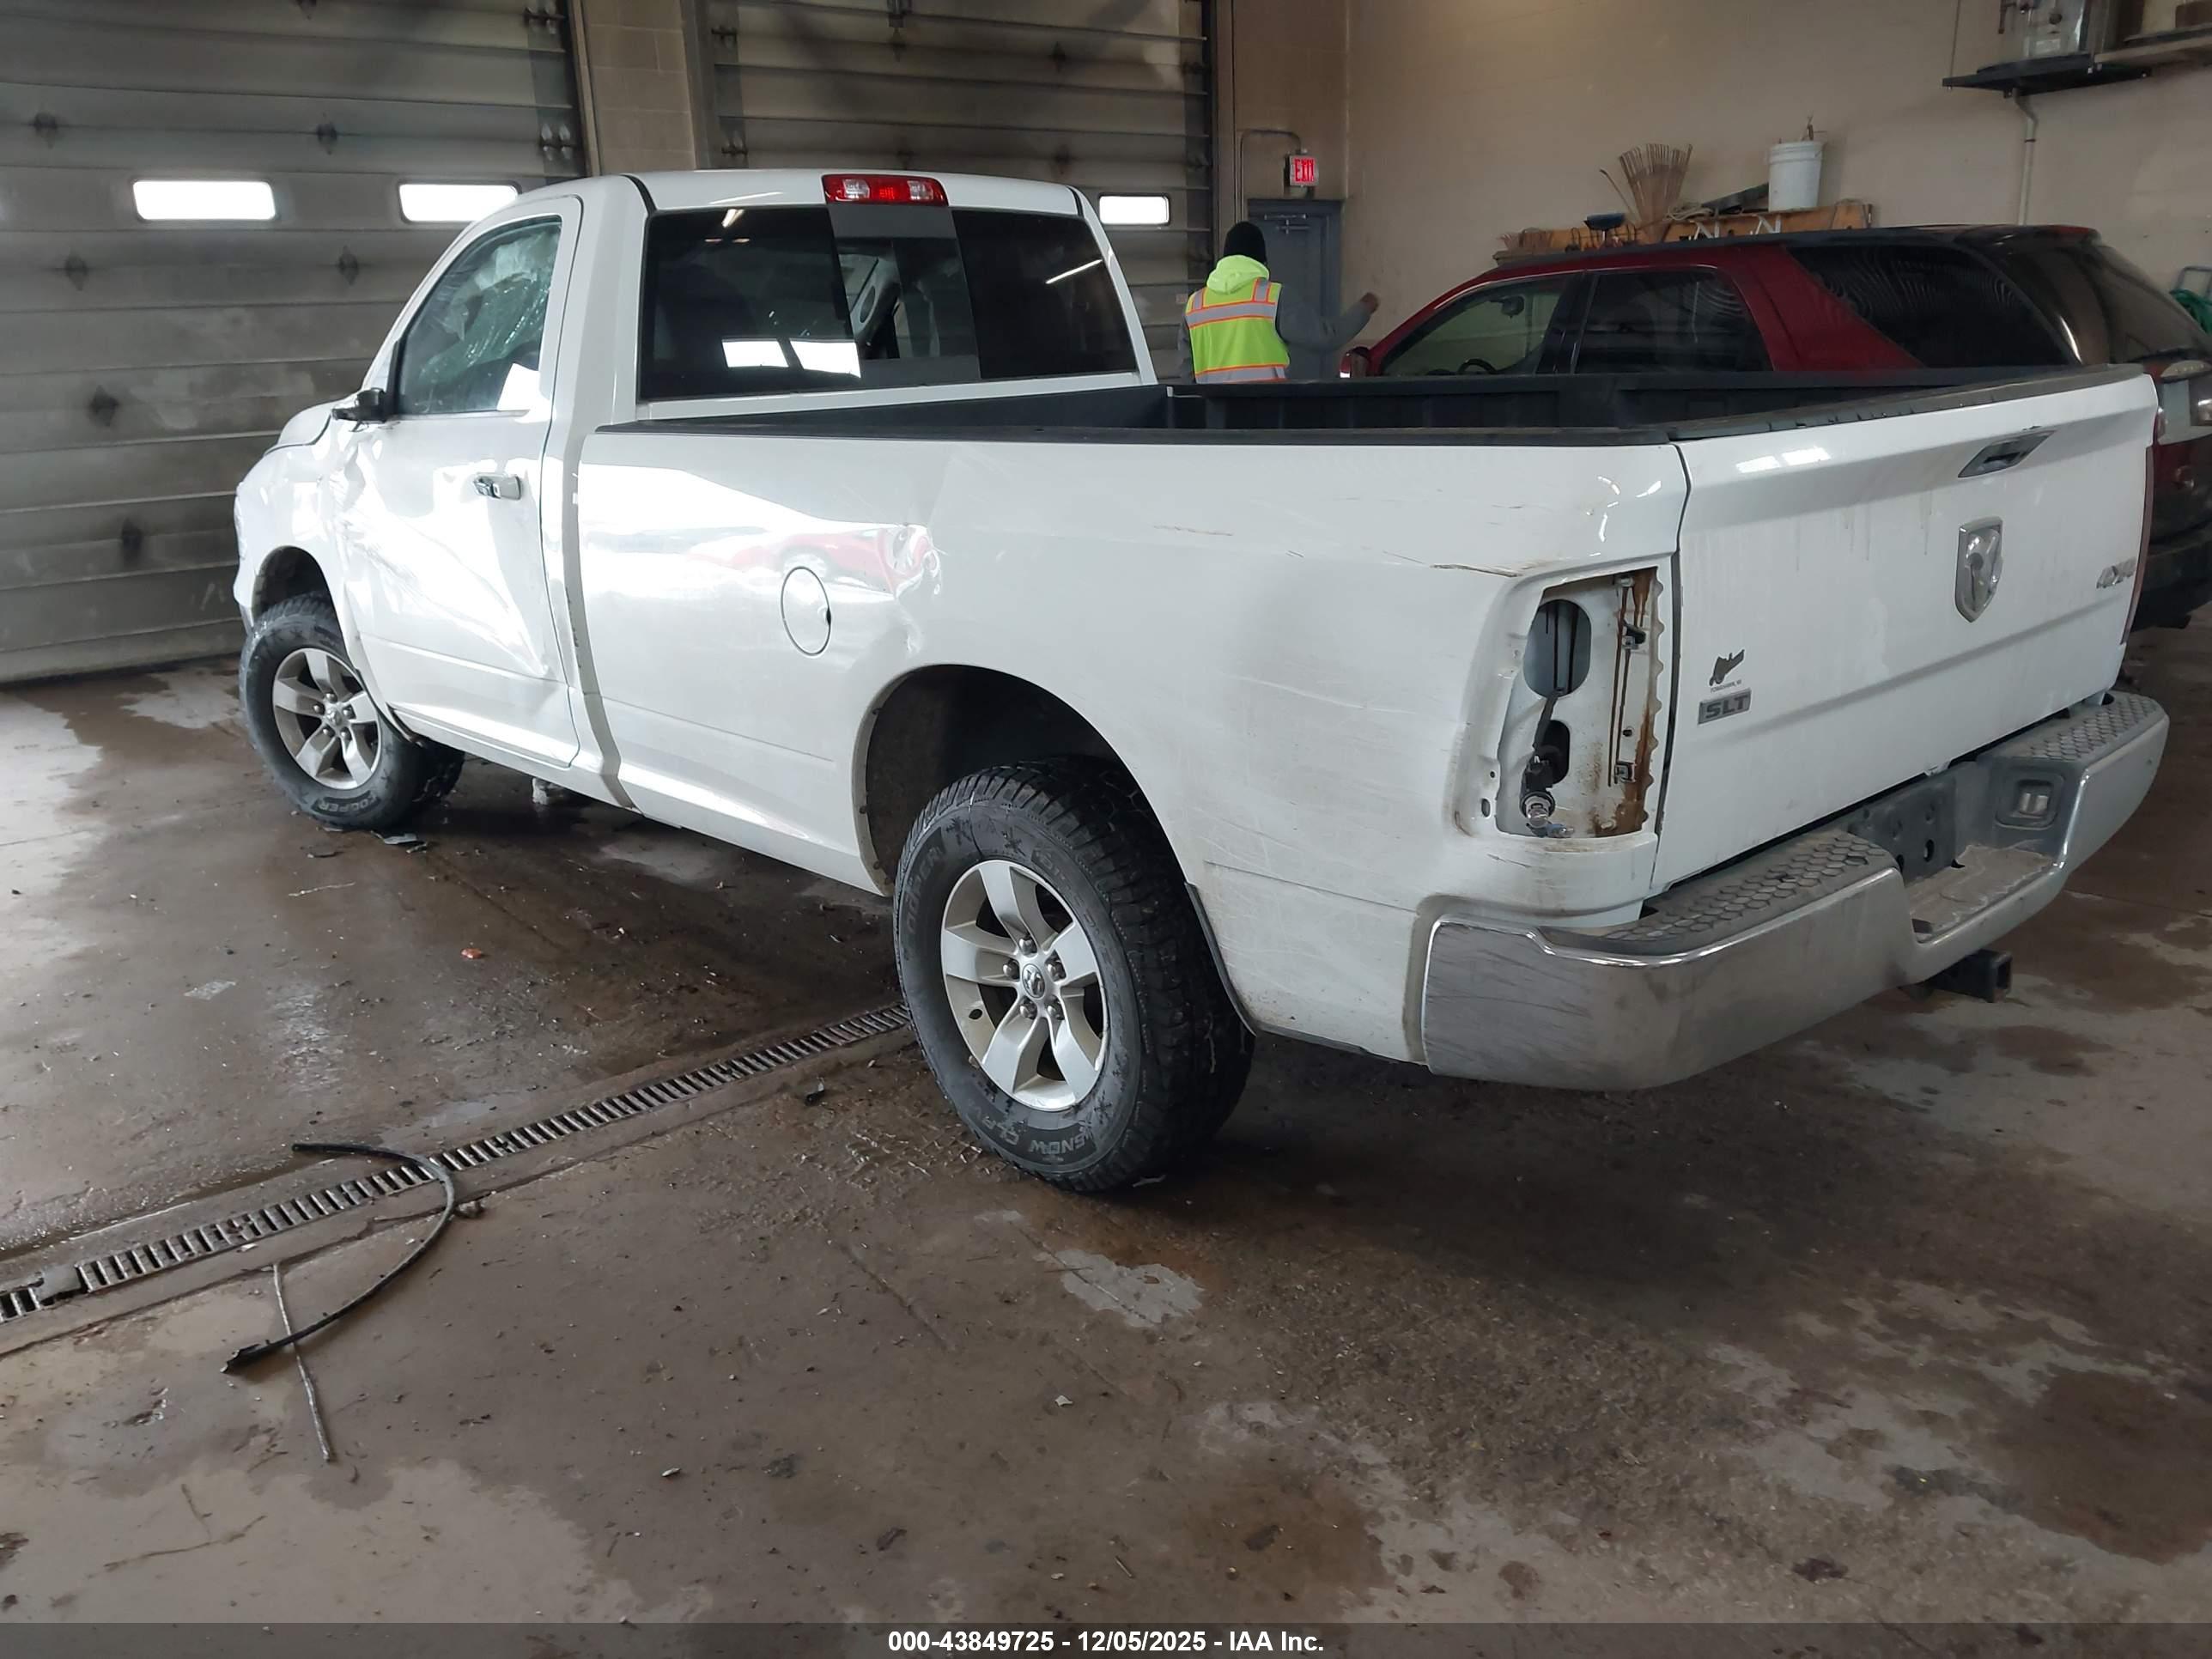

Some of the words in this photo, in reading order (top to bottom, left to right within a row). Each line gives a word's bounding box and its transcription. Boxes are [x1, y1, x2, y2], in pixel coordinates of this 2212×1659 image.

[1294, 158, 1315, 182] EXIT
[1705, 694, 1748, 719] SLT
[1028, 1133, 1086, 1156] SNOW
